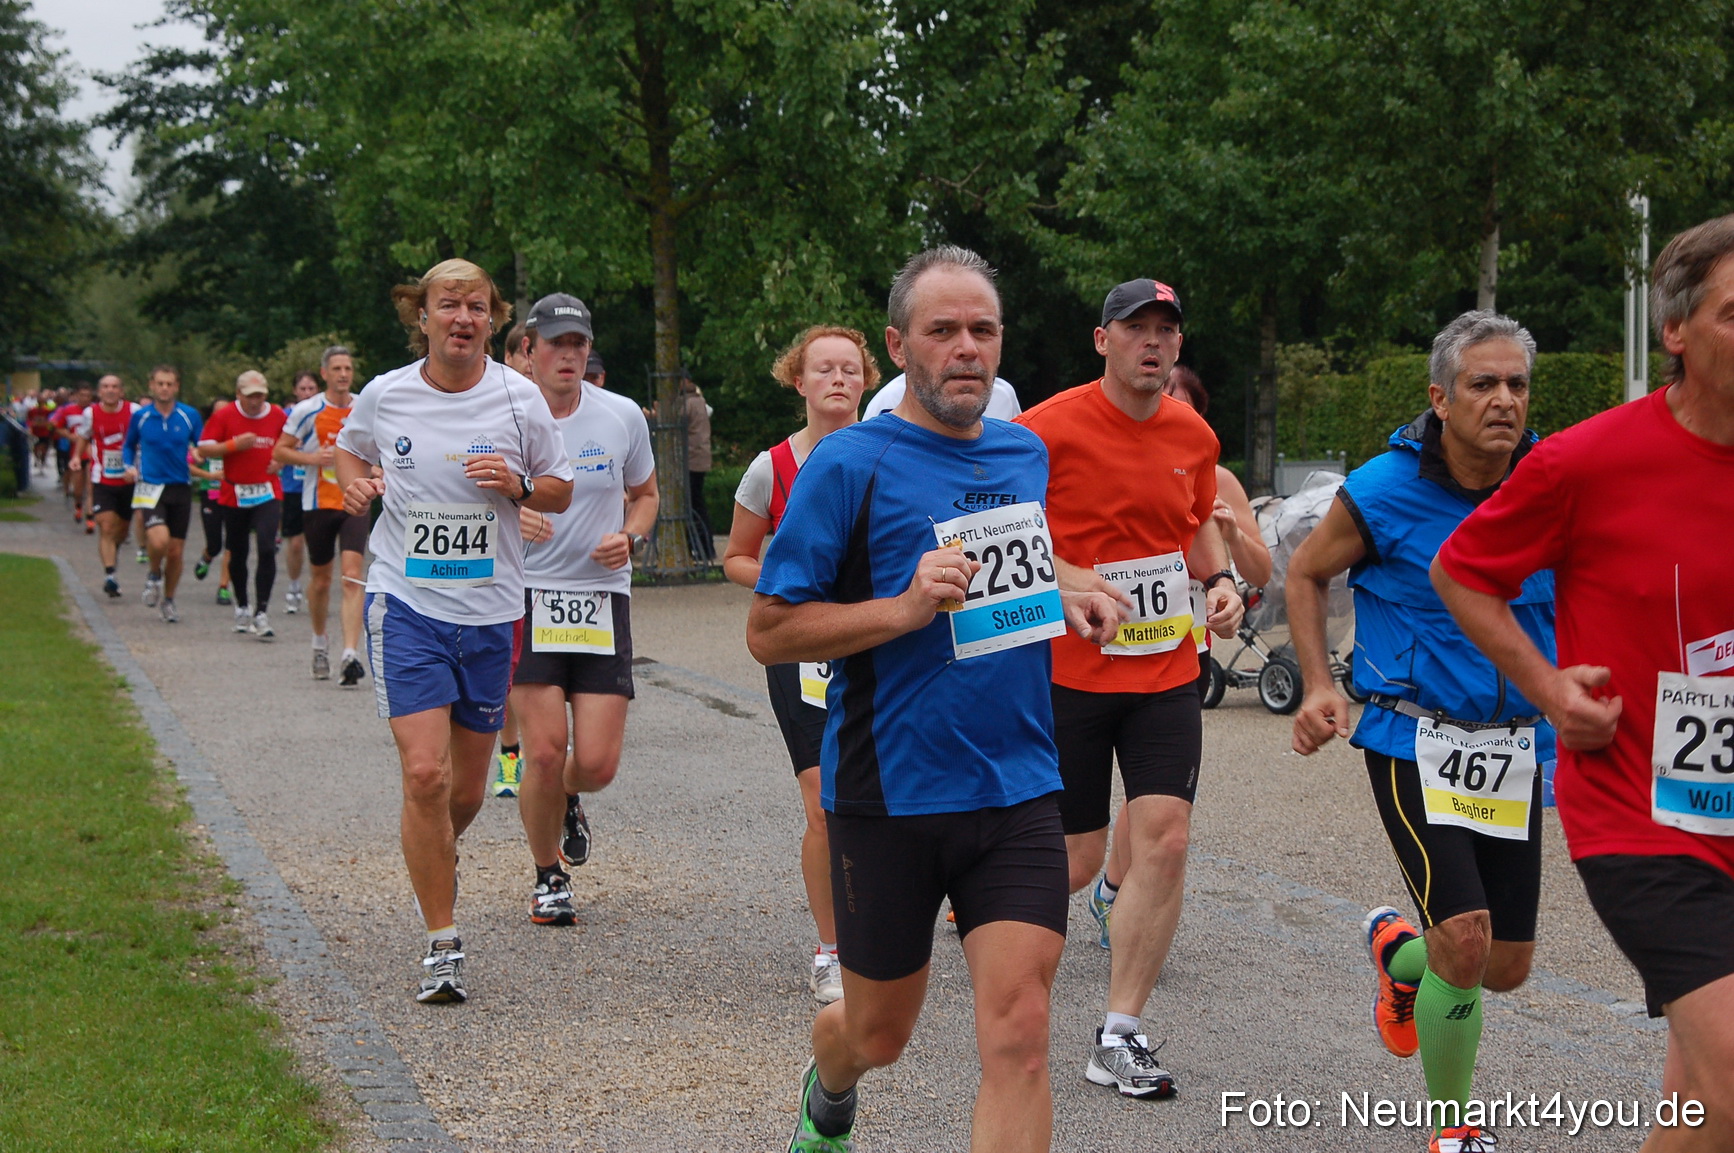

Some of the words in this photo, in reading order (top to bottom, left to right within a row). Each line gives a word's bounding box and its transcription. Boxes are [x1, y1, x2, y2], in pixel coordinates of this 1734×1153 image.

[964, 492, 1021, 505] ERTEL
[408, 510, 436, 520] PARTL
[438, 512, 482, 521] Neumarkt
[983, 517, 1034, 538] Neumarkt
[413, 524, 488, 556] 2644
[430, 563, 469, 577] Achim
[1133, 564, 1172, 580] Neumarkt
[1129, 580, 1168, 618] 16
[550, 599, 598, 626] 582
[991, 604, 1046, 630] Stefan
[541, 629, 590, 643] Michael
[1123, 625, 1176, 642] Matthias
[1715, 641, 1734, 661] DE
[1662, 688, 1720, 708] PARTL
[1419, 727, 1458, 746] PARTL
[1460, 737, 1514, 750] Neumarkt
[1438, 748, 1513, 793] 467
[1451, 796, 1496, 821] Bagher
